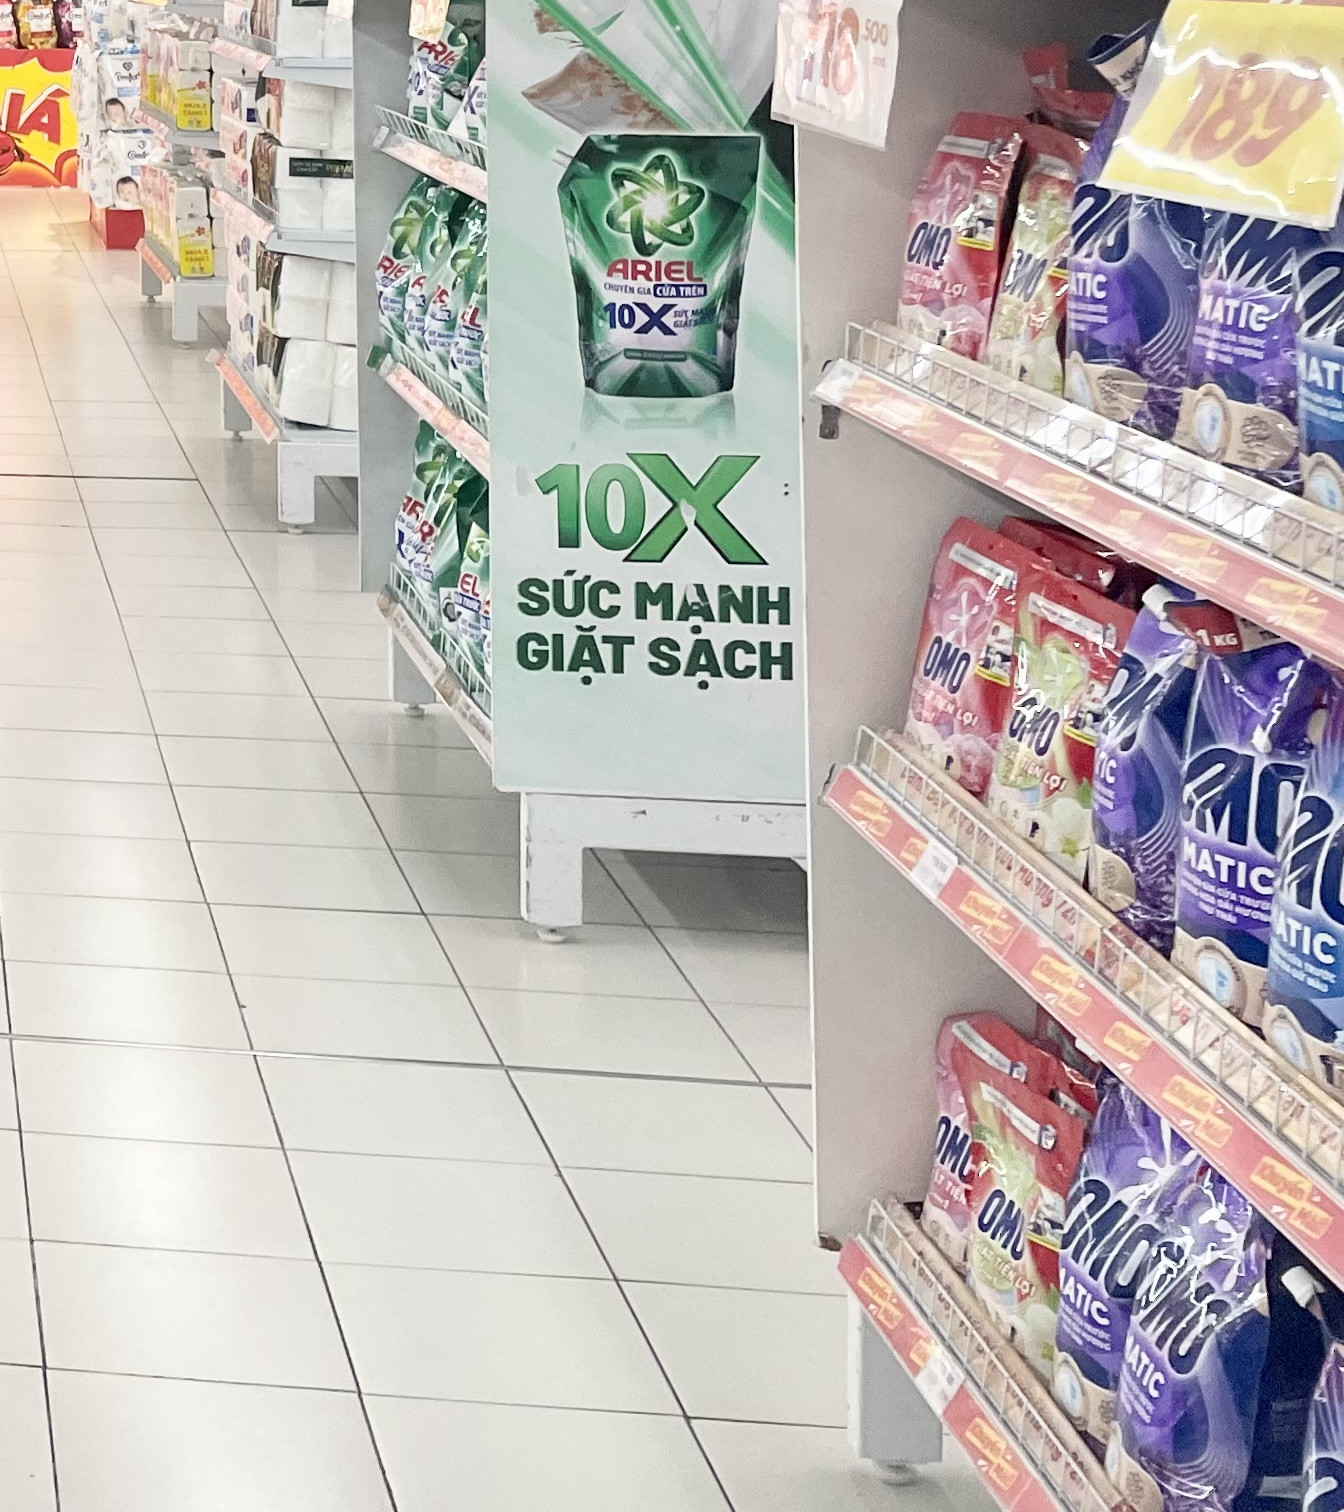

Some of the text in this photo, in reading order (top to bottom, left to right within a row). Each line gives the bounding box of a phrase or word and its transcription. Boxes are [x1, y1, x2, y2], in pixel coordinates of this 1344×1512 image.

[1167, 50, 1326, 167] 189
[606, 258, 704, 283] ARIEL
[907, 221, 950, 270] OMO
[603, 301, 678, 336] 10X
[1199, 294, 1269, 334] MATIC
[535, 452, 770, 566] 10X
[517, 569, 791, 635] SỨC MẠNH
[516, 624, 794, 690] GIẶT SẠCH
[922, 635, 971, 695] OMO
[1196, 629, 1238, 648] 1 KG
[1182, 835, 1276, 896] MATIC
[976, 1188, 1026, 1262] OMO
